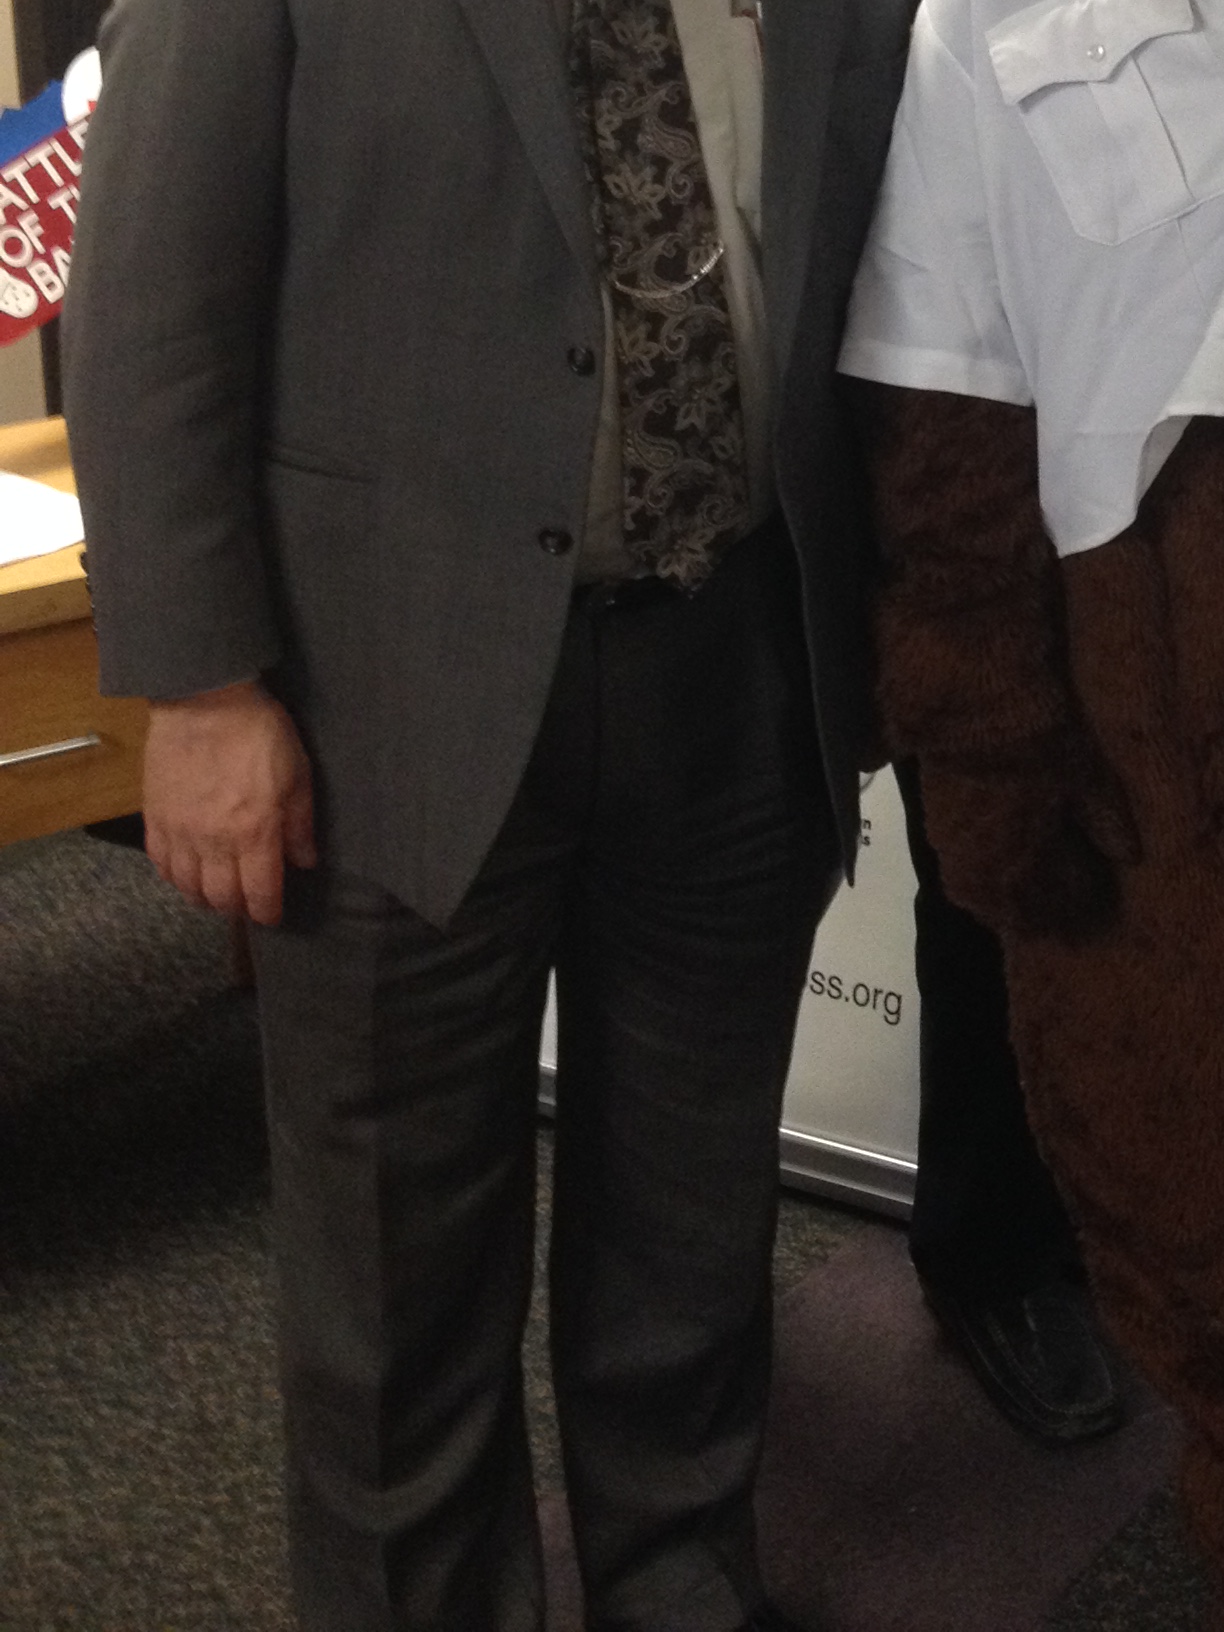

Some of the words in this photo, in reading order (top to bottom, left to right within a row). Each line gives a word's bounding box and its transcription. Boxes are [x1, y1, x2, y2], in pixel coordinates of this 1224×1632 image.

[0, 206, 46, 268] OF
[47, 183, 81, 224] T
[26, 235, 75, 304] BA
